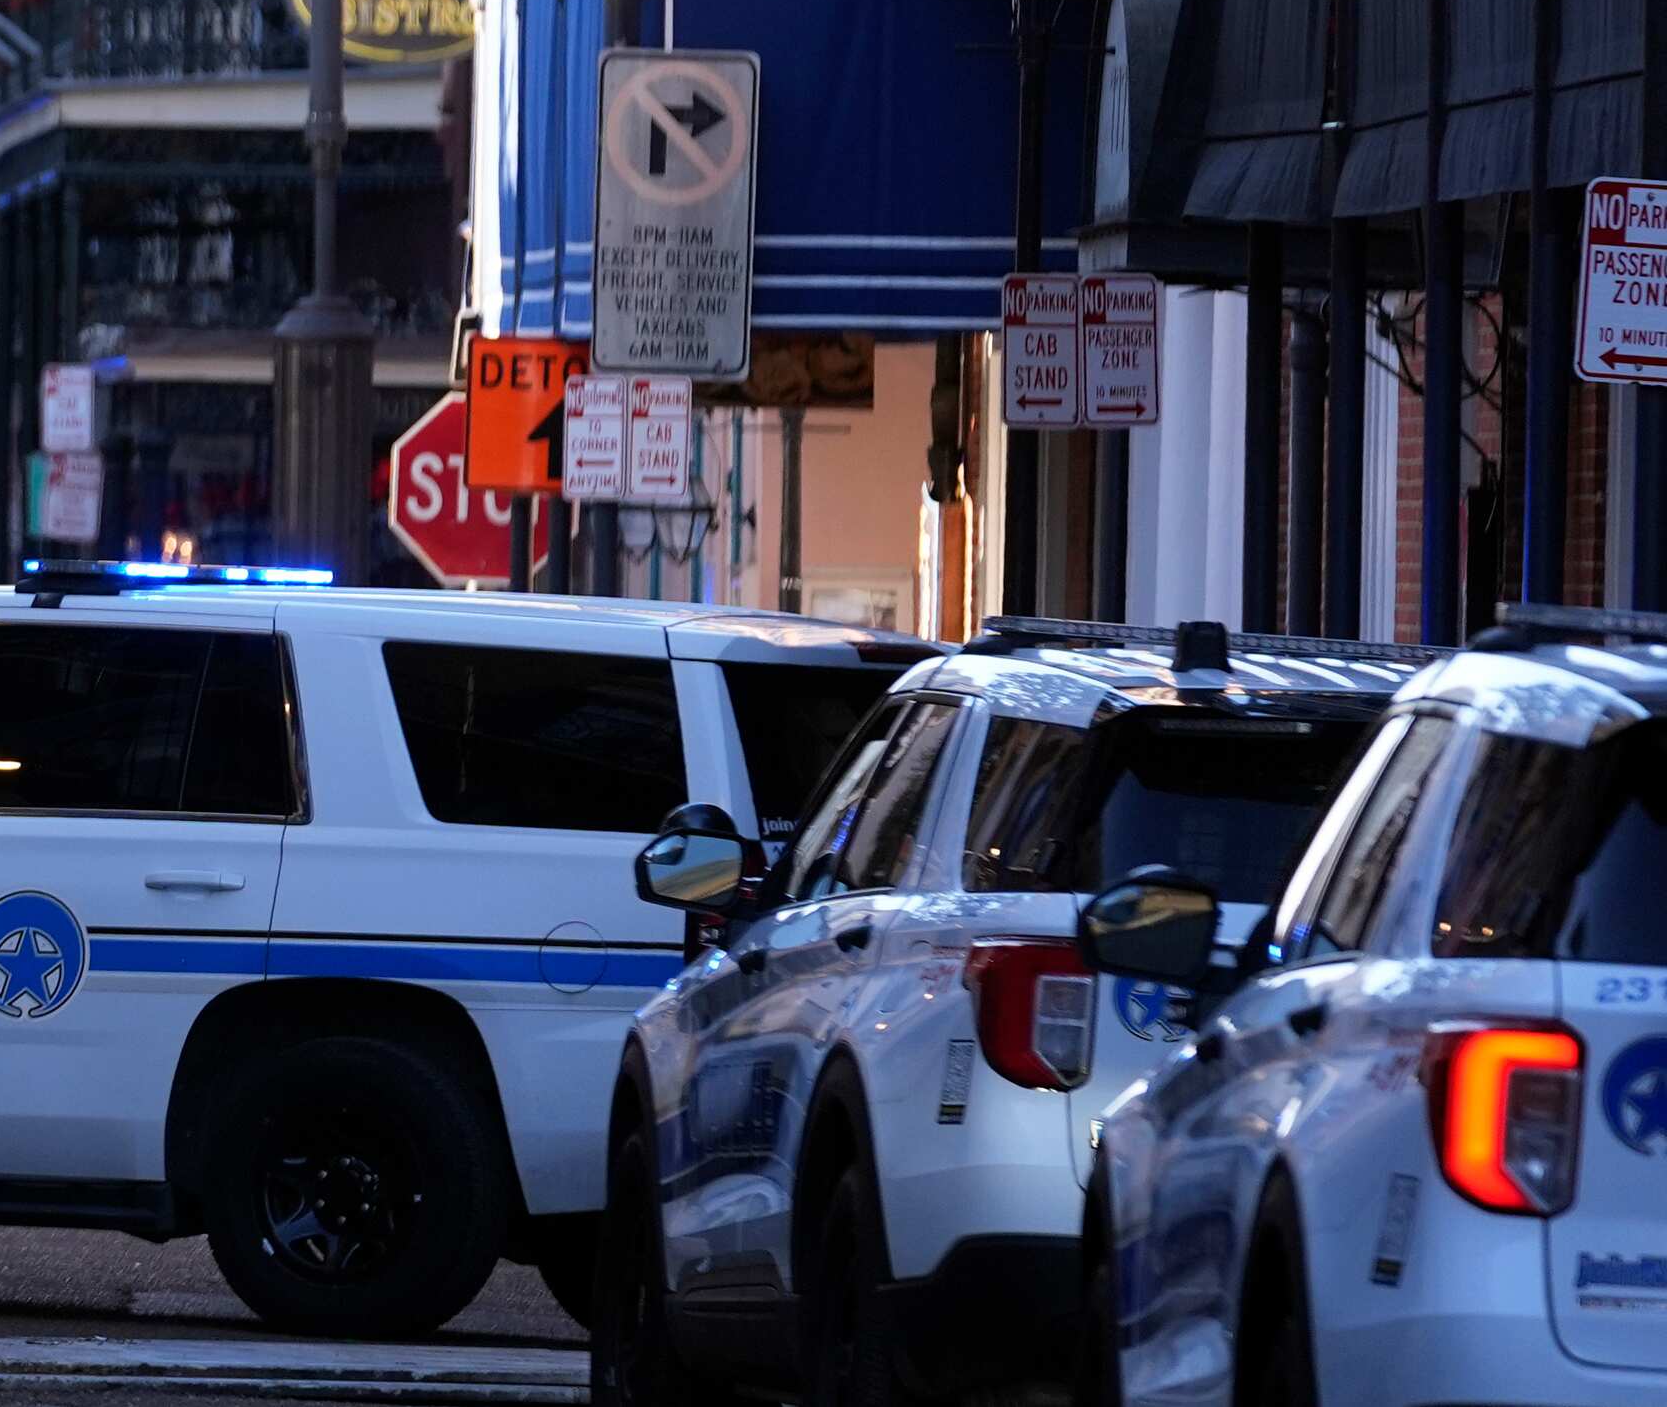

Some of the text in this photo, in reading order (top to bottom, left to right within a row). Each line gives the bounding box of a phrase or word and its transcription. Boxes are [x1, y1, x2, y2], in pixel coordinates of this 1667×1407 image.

[1591, 192, 1625, 230] NO
[601, 246, 658, 267] EXCEPT
[1593, 249, 1667, 278] PASSEN
[677, 273, 740, 293] SERVICE
[615, 293, 727, 316] VEHICLES AND
[1006, 286, 1075, 317] NO PARKING
[1084, 285, 1153, 315] NO PARKING
[635, 317, 706, 338] TAXICABS
[1088, 327, 1152, 349] PASSENGER
[1598, 326, 1667, 347] 10 MINUT
[1025, 332, 1058, 357] CAB
[1102, 349, 1140, 370] ZONE
[480, 353, 588, 390] DETO
[1015, 365, 1068, 391] STAND
[568, 386, 585, 410] NO
[632, 386, 650, 411] NO
[1109, 384, 1148, 400] MINUTES
[588, 418, 602, 434] TO
[646, 423, 672, 443] CAB
[571, 437, 618, 451] CORNER
[638, 450, 680, 468] STAND
[405, 451, 512, 526] ST
